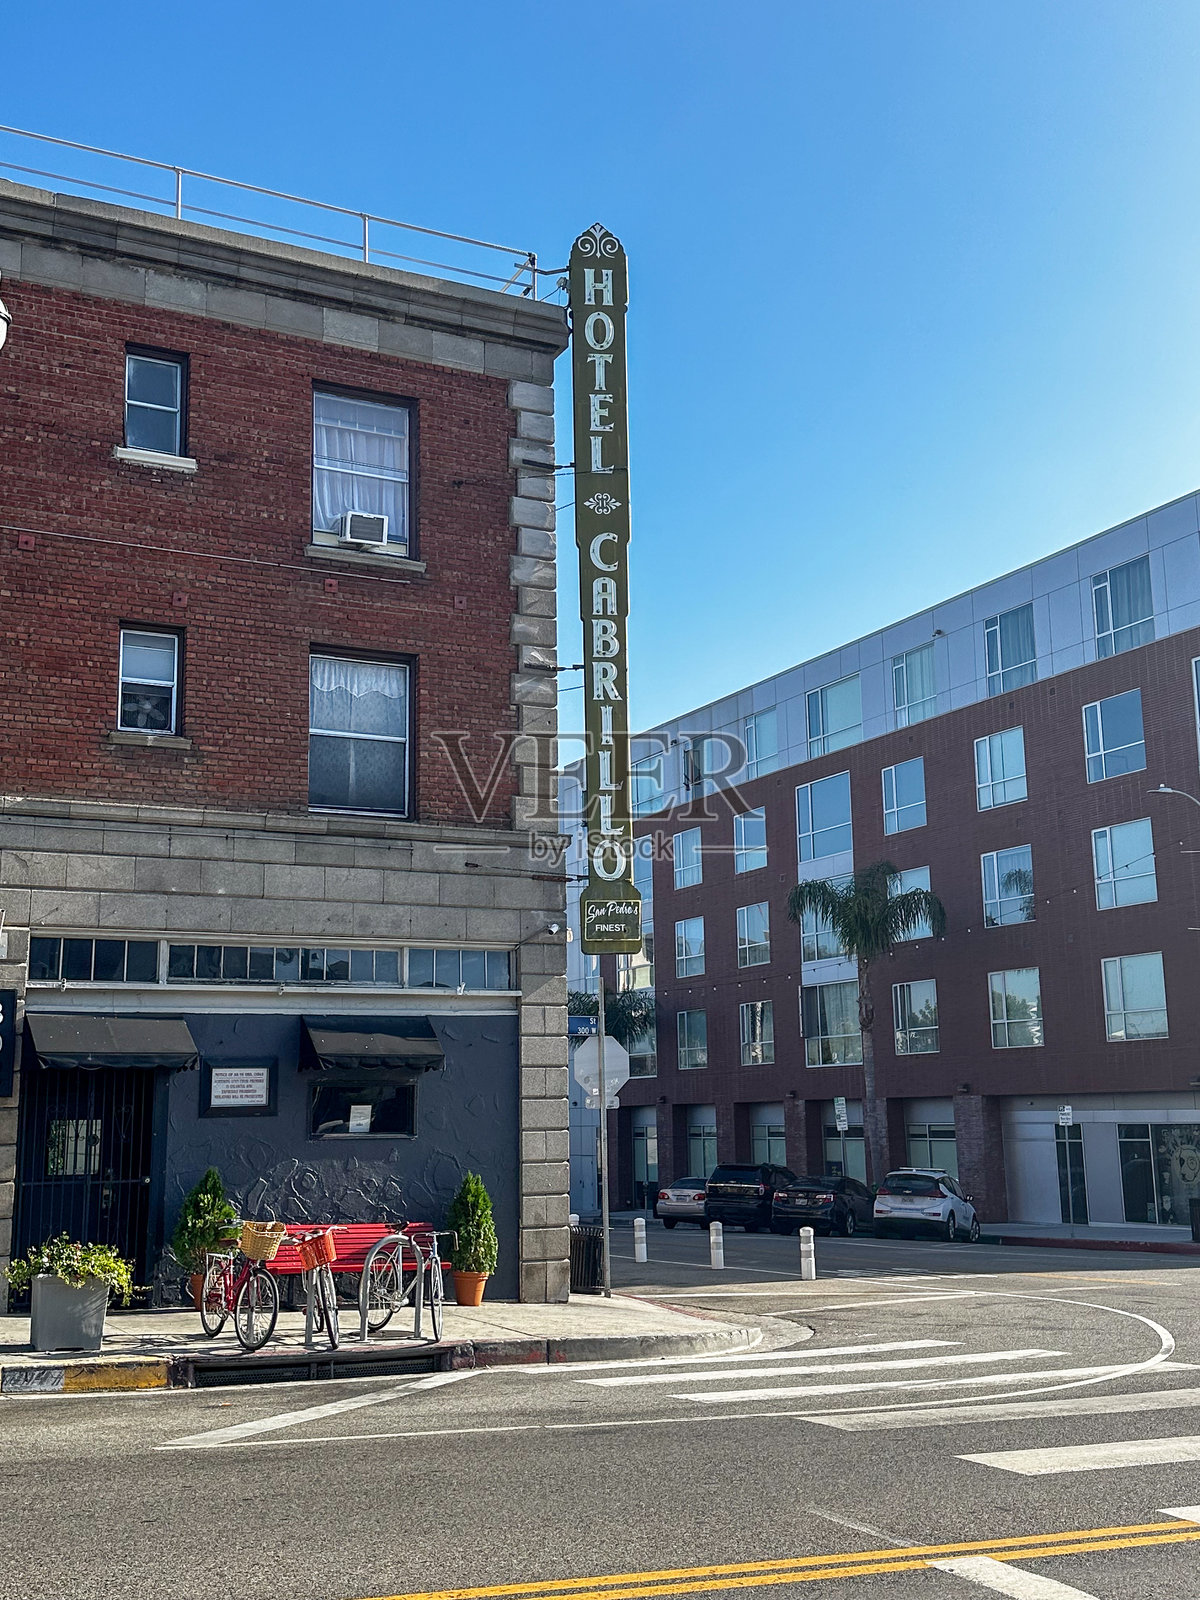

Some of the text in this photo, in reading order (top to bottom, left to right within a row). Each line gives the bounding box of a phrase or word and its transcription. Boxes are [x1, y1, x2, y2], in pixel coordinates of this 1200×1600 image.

[586, 268, 627, 882] HOTEL CABRILLO
[586, 901, 639, 924] San Pedro's
[595, 923, 626, 932] FINEST
[589, 1017, 597, 1025] St
[577, 1026, 590, 1035] 300
